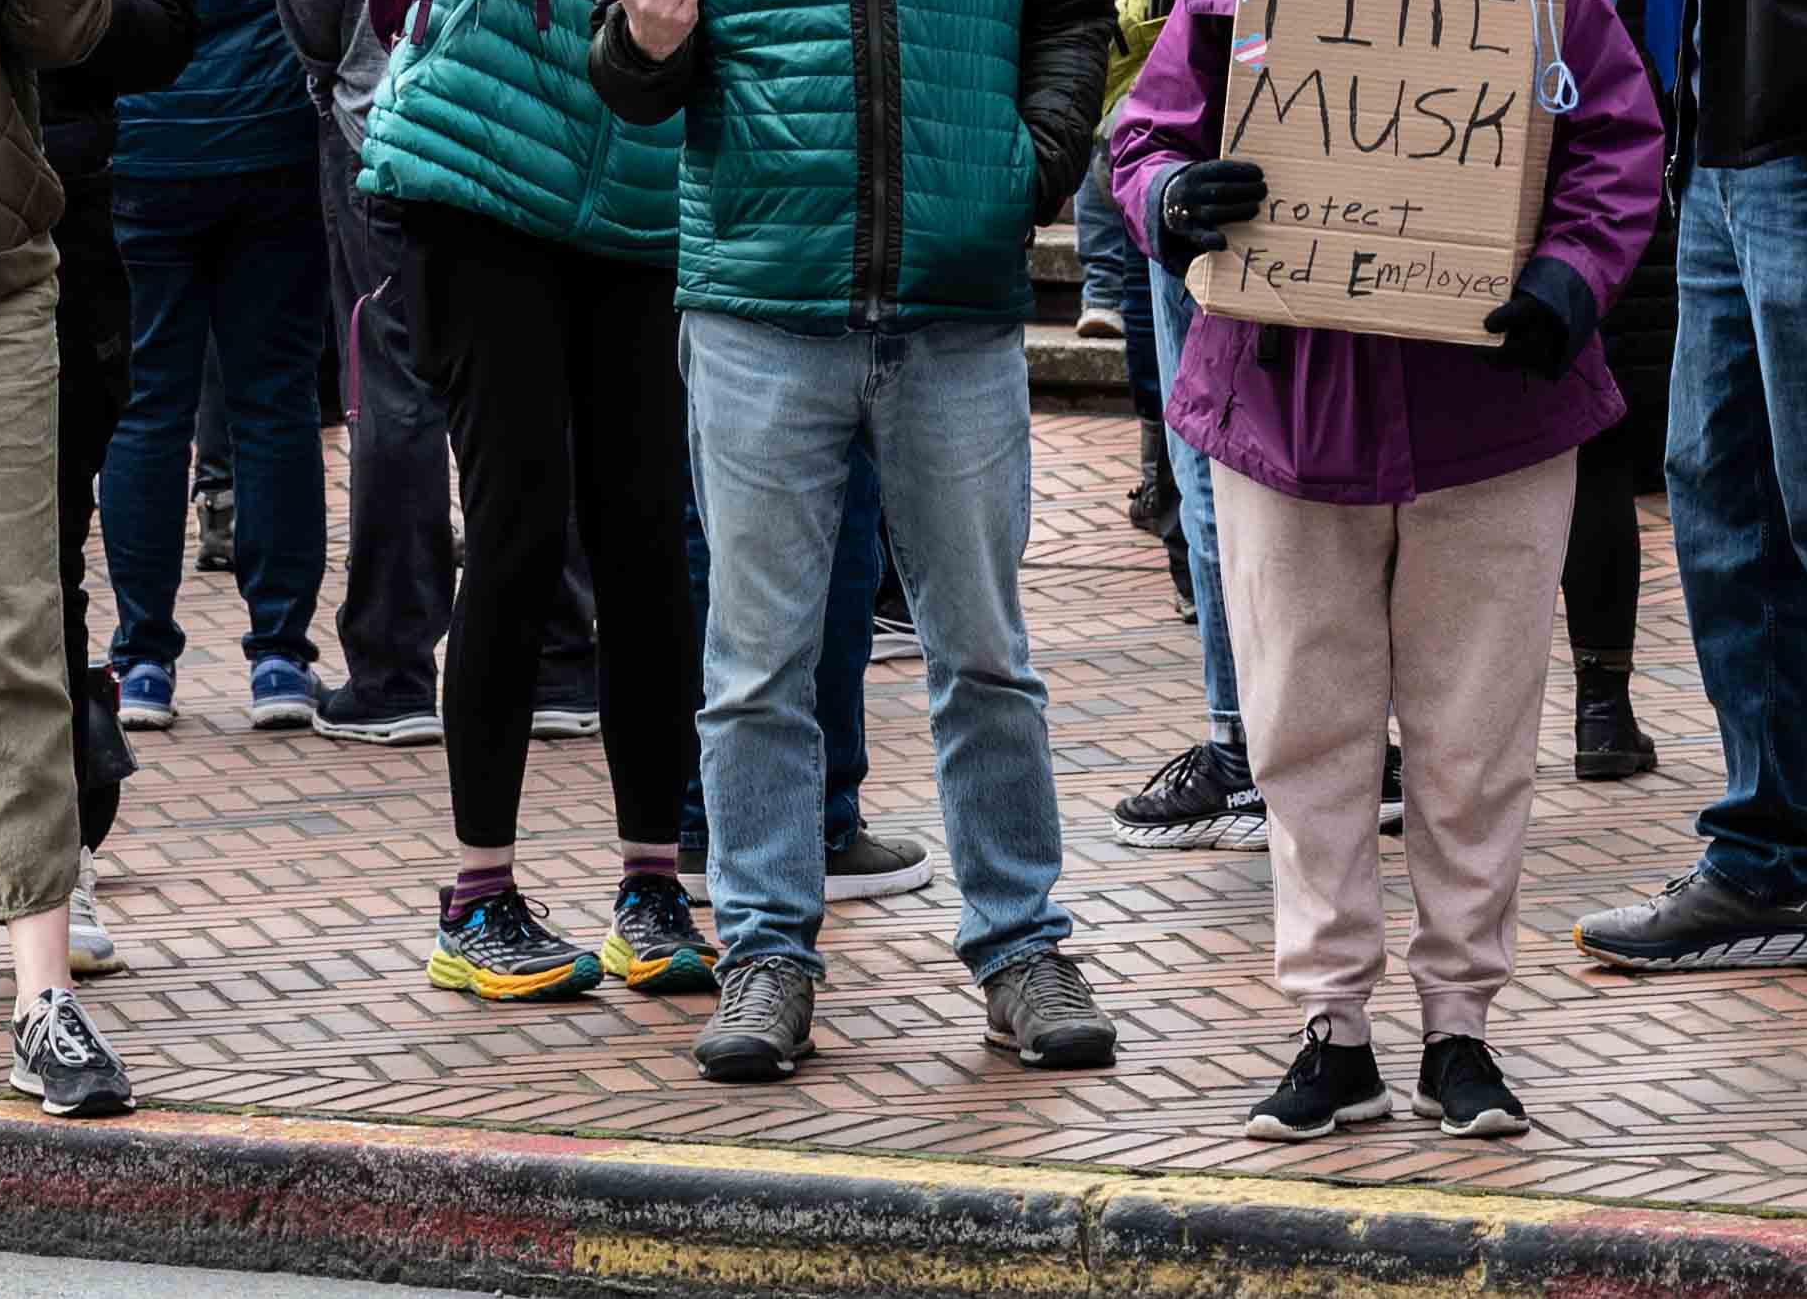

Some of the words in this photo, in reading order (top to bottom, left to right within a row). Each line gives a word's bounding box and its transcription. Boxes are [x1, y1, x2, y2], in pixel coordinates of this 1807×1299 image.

[1228, 67, 1517, 168] MUSK
[1268, 199, 1424, 236] rotect
[1241, 239, 1317, 293] Fed
[1346, 250, 1512, 298] Employee
